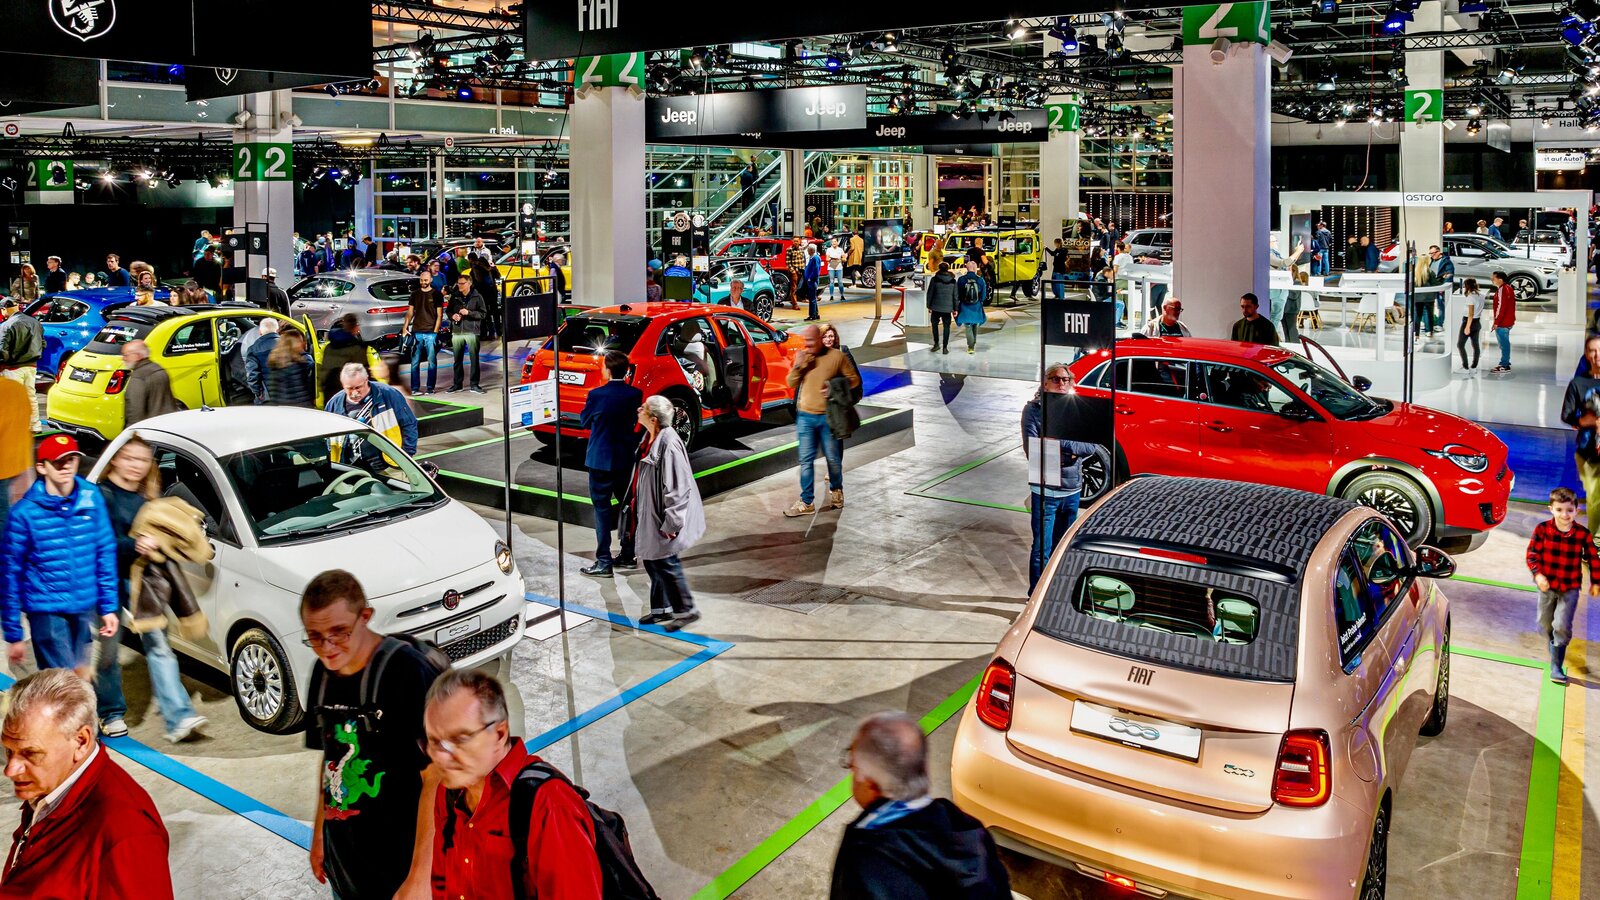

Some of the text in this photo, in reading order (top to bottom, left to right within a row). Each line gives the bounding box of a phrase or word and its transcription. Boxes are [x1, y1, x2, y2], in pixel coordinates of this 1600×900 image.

[661, 107, 698, 125] Jeep
[805, 101, 847, 119] Jeep
[1412, 92, 1434, 120] 2
[997, 120, 1032, 134] Jeep
[1048, 106, 1064, 130] 2
[1071, 106, 1079, 130] 2
[1559, 119, 1581, 128] Hall
[876, 124, 906, 138] Jeep
[238, 147, 252, 178] 2
[264, 147, 287, 178] 2
[27, 161, 37, 187] 2
[1405, 193, 1444, 202] astara
[520, 306, 540, 328] FIAT
[1064, 312, 1091, 334] FIAT
[1127, 665, 1156, 686] FIAT
